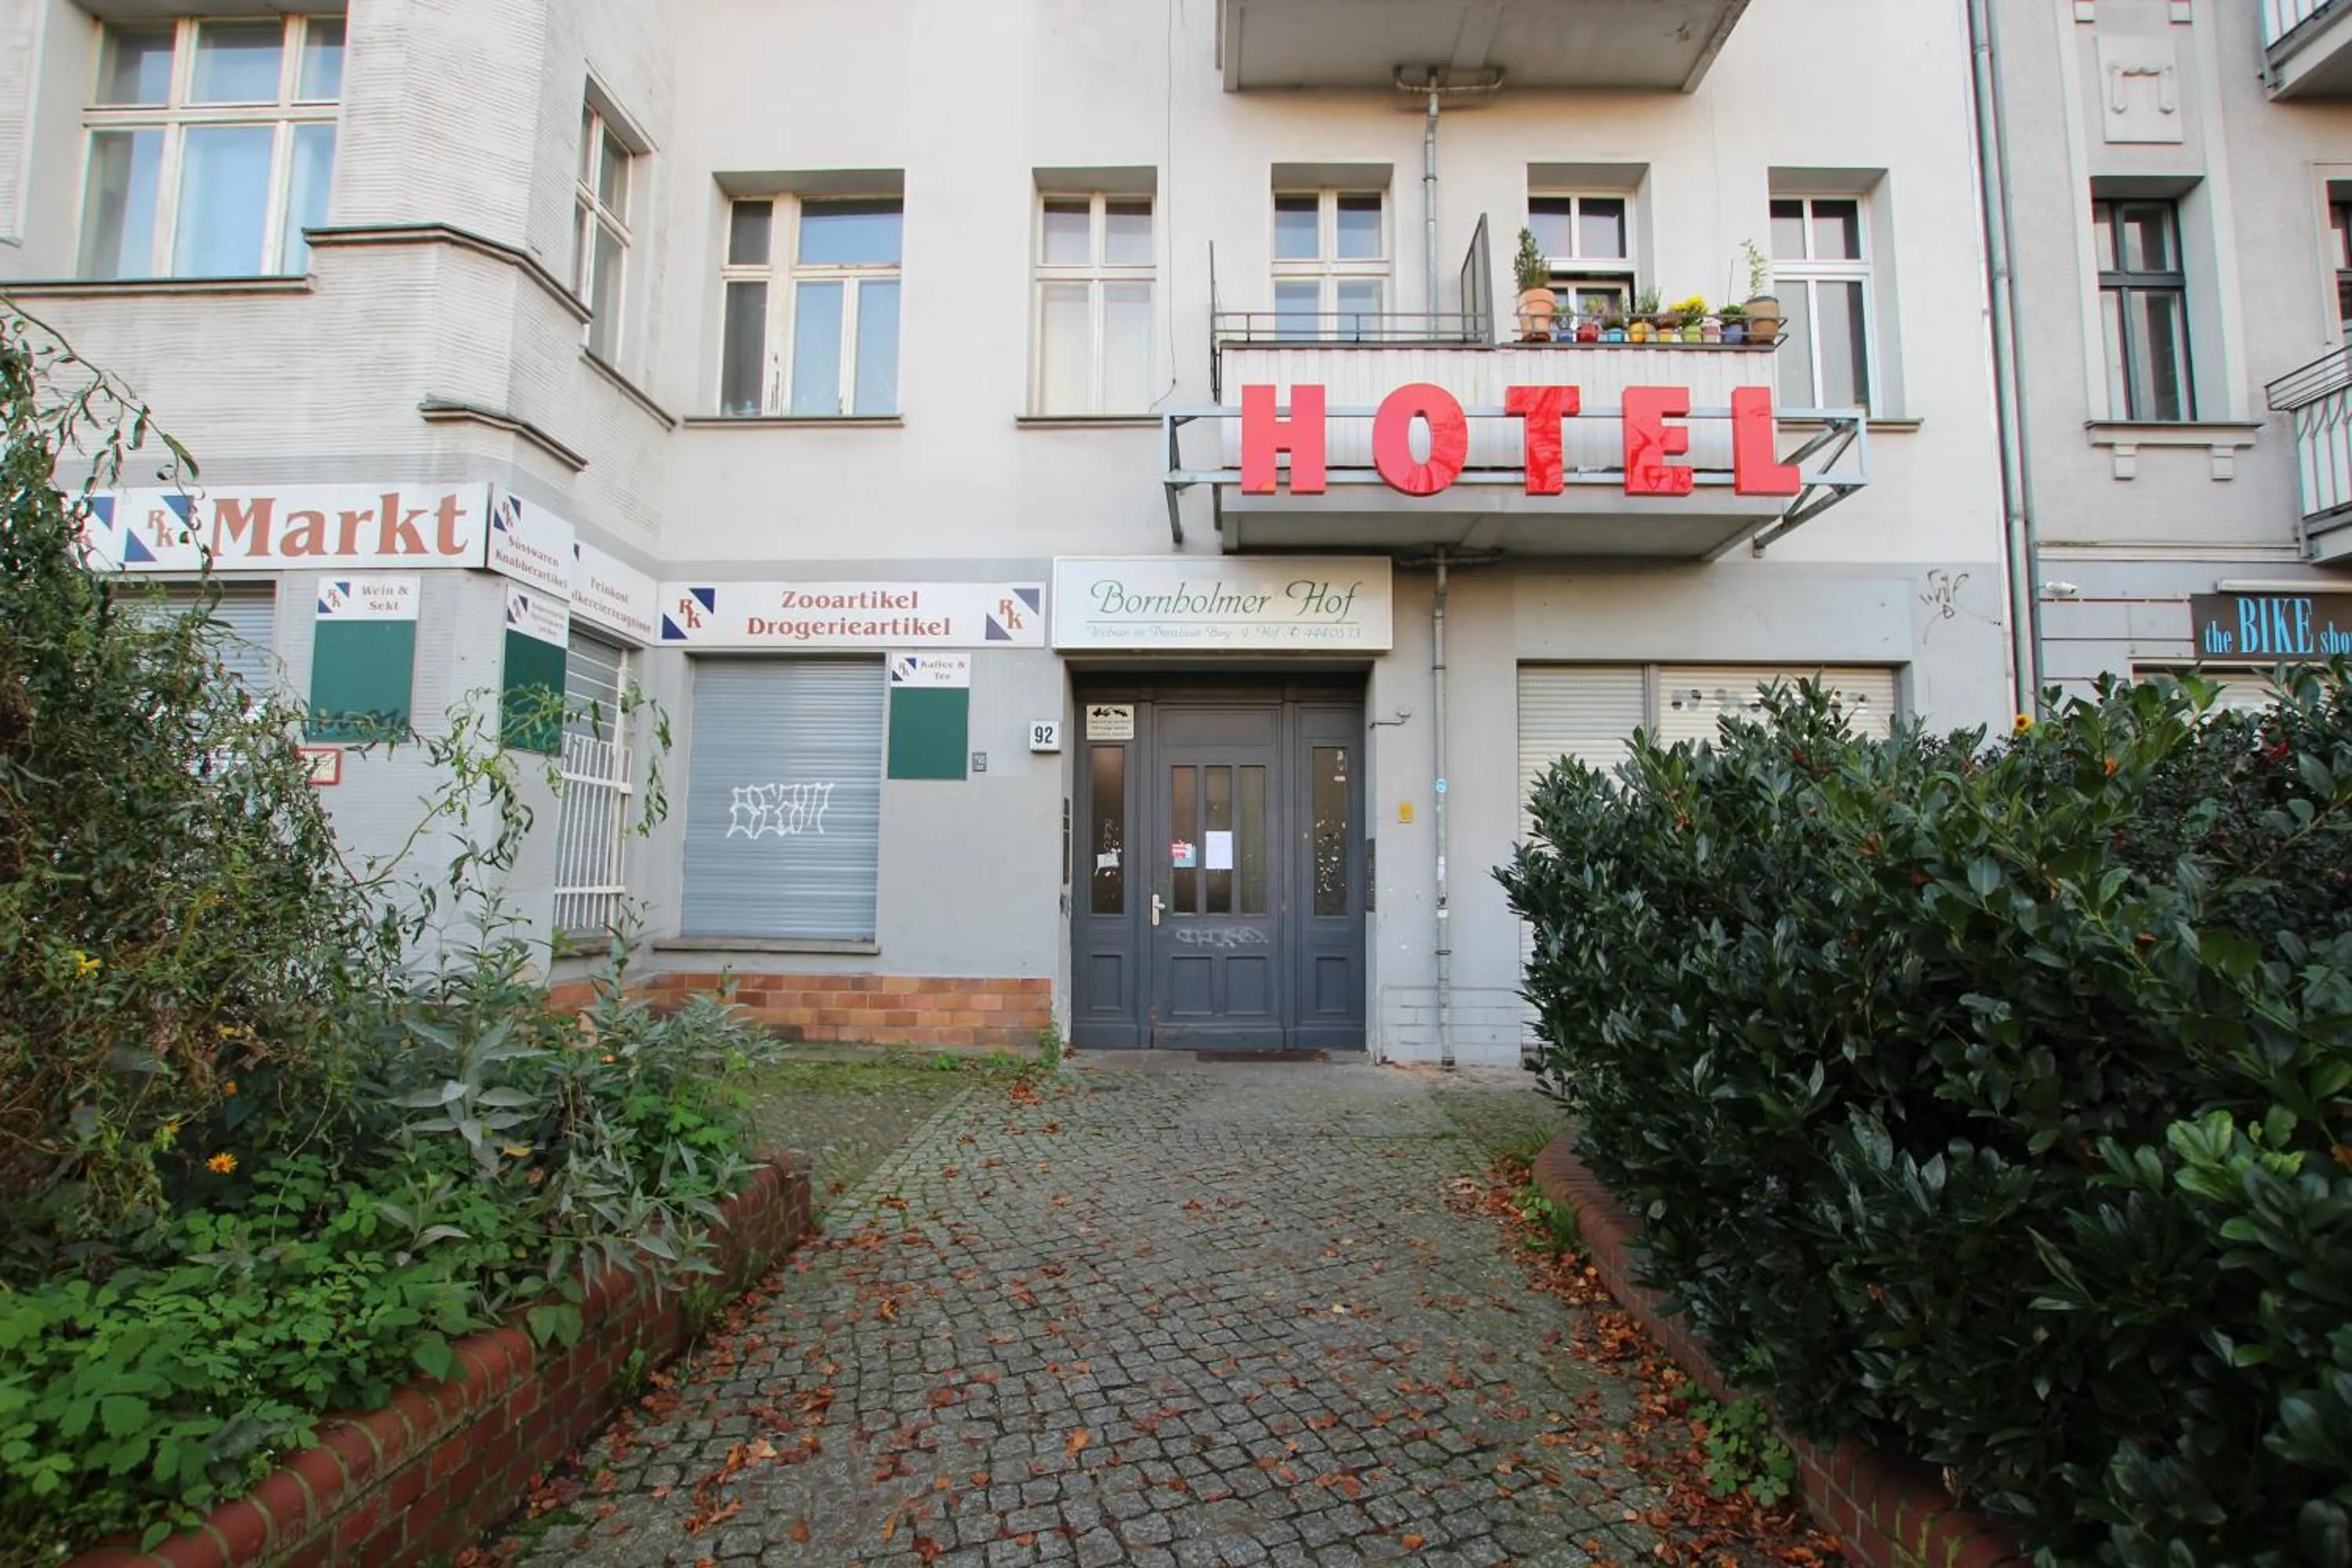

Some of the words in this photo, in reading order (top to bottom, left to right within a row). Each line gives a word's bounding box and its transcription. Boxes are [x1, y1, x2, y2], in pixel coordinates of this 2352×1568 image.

[1242, 383, 1801, 496] HOTEL
[211, 492, 468, 557] Markt
[362, 585, 393, 597] Wein
[397, 584, 410, 596] &
[781, 590, 919, 610] Zooartikel
[1091, 579, 1272, 615] Bornholmer
[1286, 579, 1363, 624] Hof
[368, 600, 399, 611] Sekt
[747, 616, 951, 640] Drogerieartikel
[2205, 620, 2233, 654] the
[2236, 597, 2314, 654] BIKE
[2320, 620, 2352, 655] sho
[1034, 726, 1054, 745] 92
